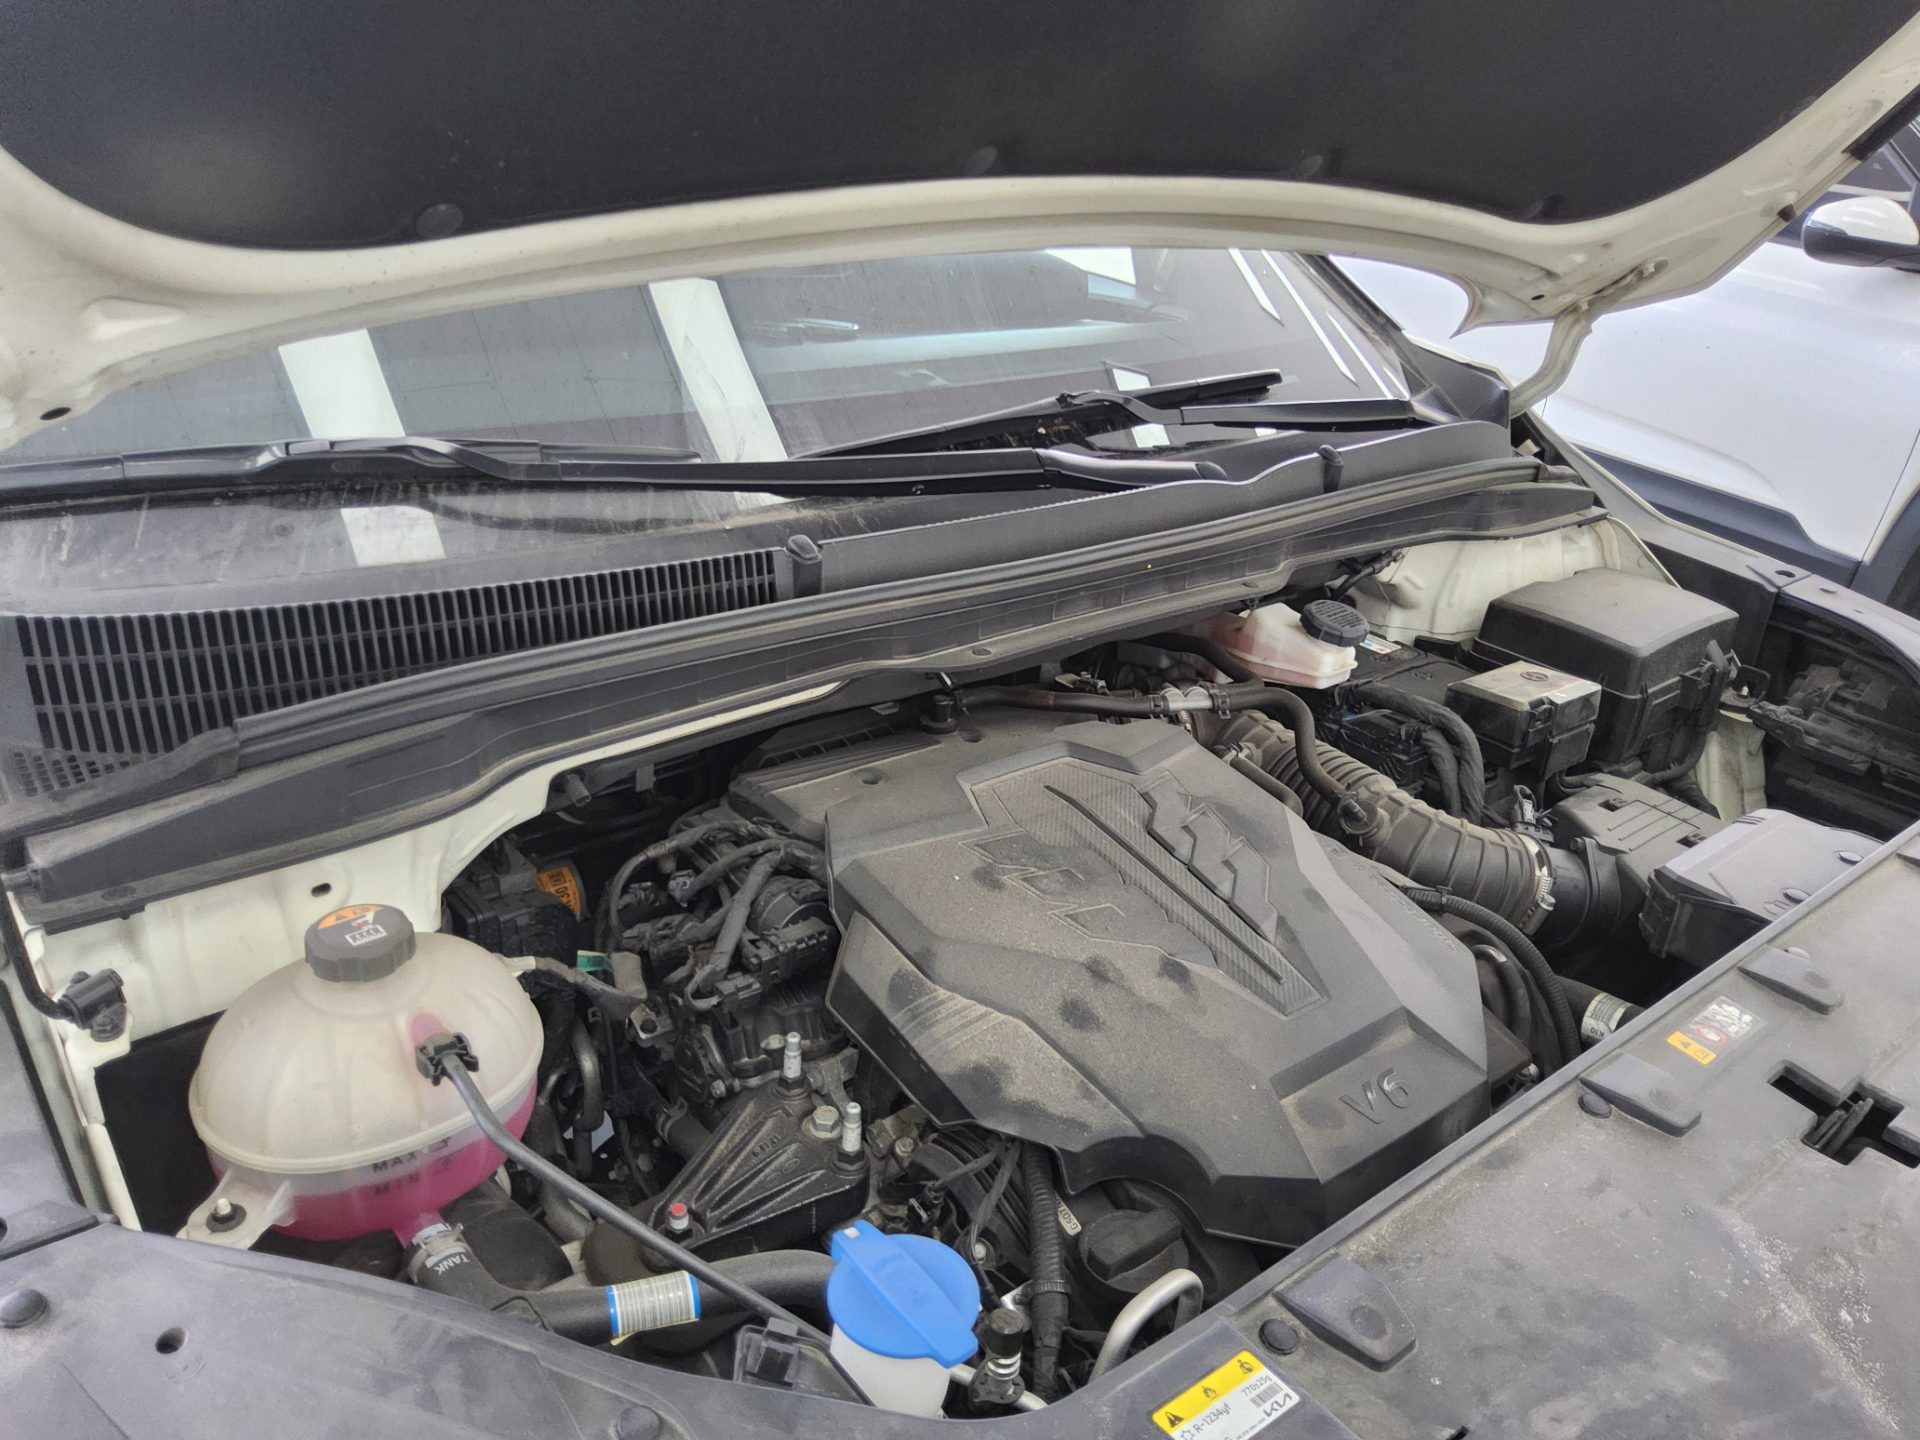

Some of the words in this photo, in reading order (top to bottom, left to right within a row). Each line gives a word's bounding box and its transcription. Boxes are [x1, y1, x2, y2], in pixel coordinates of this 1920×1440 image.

[1339, 1067, 1412, 1124] V6
[372, 1151, 417, 1173] MAX
[374, 1172, 421, 1197] MIN
[433, 1254, 470, 1276] TANK
[1192, 1403, 1231, 1433] R-1234yf
